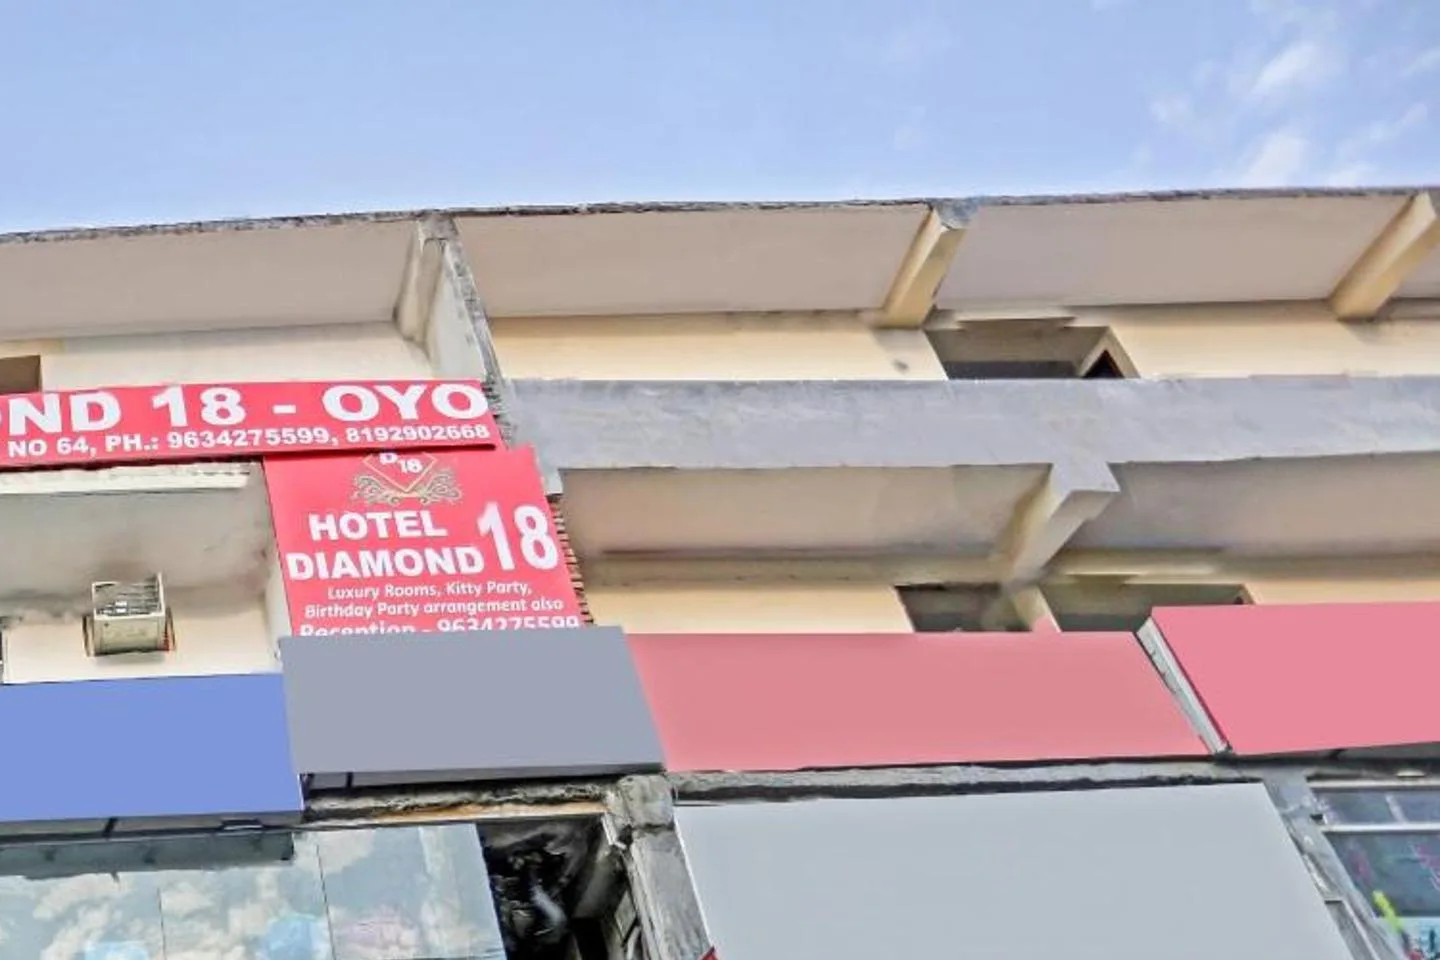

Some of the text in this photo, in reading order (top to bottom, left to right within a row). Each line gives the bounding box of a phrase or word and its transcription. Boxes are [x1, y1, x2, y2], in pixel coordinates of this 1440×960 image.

[152, 385, 246, 429] 18
[322, 383, 488, 423] OYO
[7, 439, 47, 457] NO
[58, 437, 98, 459] 64,
[167, 427, 339, 450] 9634275599,
[346, 423, 490, 443] 8192902668
[285, 502, 559, 581] DIAMOND 18
[308, 510, 447, 542] HOTEL
[327, 580, 533, 600] Luxury Rooms, Kitty Party,
[304, 599, 564, 619] Birthday Party arrangement also
